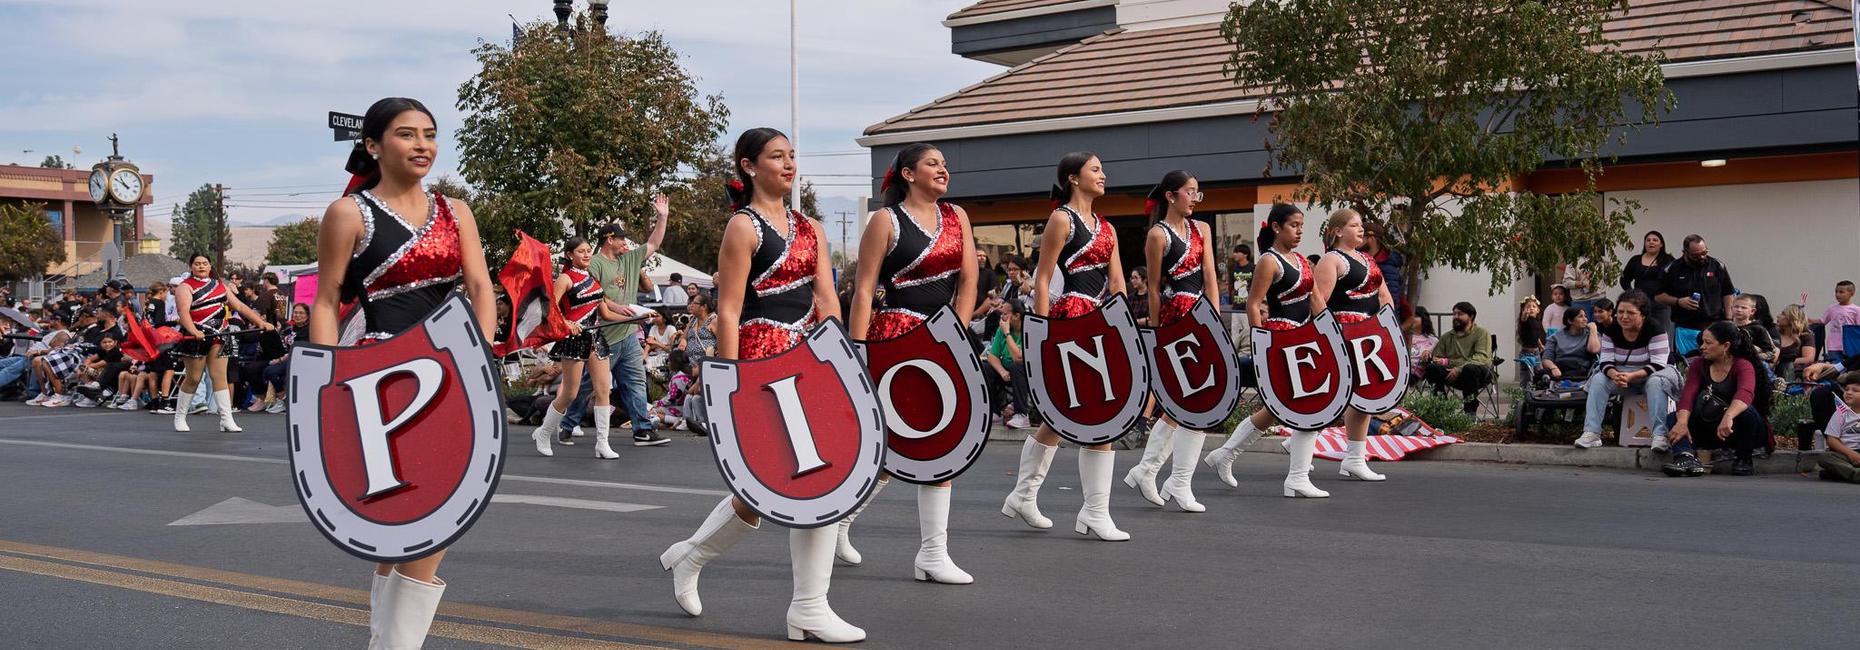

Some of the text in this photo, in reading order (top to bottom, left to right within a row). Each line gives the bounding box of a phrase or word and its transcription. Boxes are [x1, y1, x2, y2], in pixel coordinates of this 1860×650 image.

[1056, 334, 1116, 408] N
[1163, 333, 1215, 398] E
[1282, 342, 1331, 399] E
[1350, 334, 1394, 387] R
[343, 359, 443, 497] P
[763, 374, 831, 477] I
[877, 358, 957, 439] O
